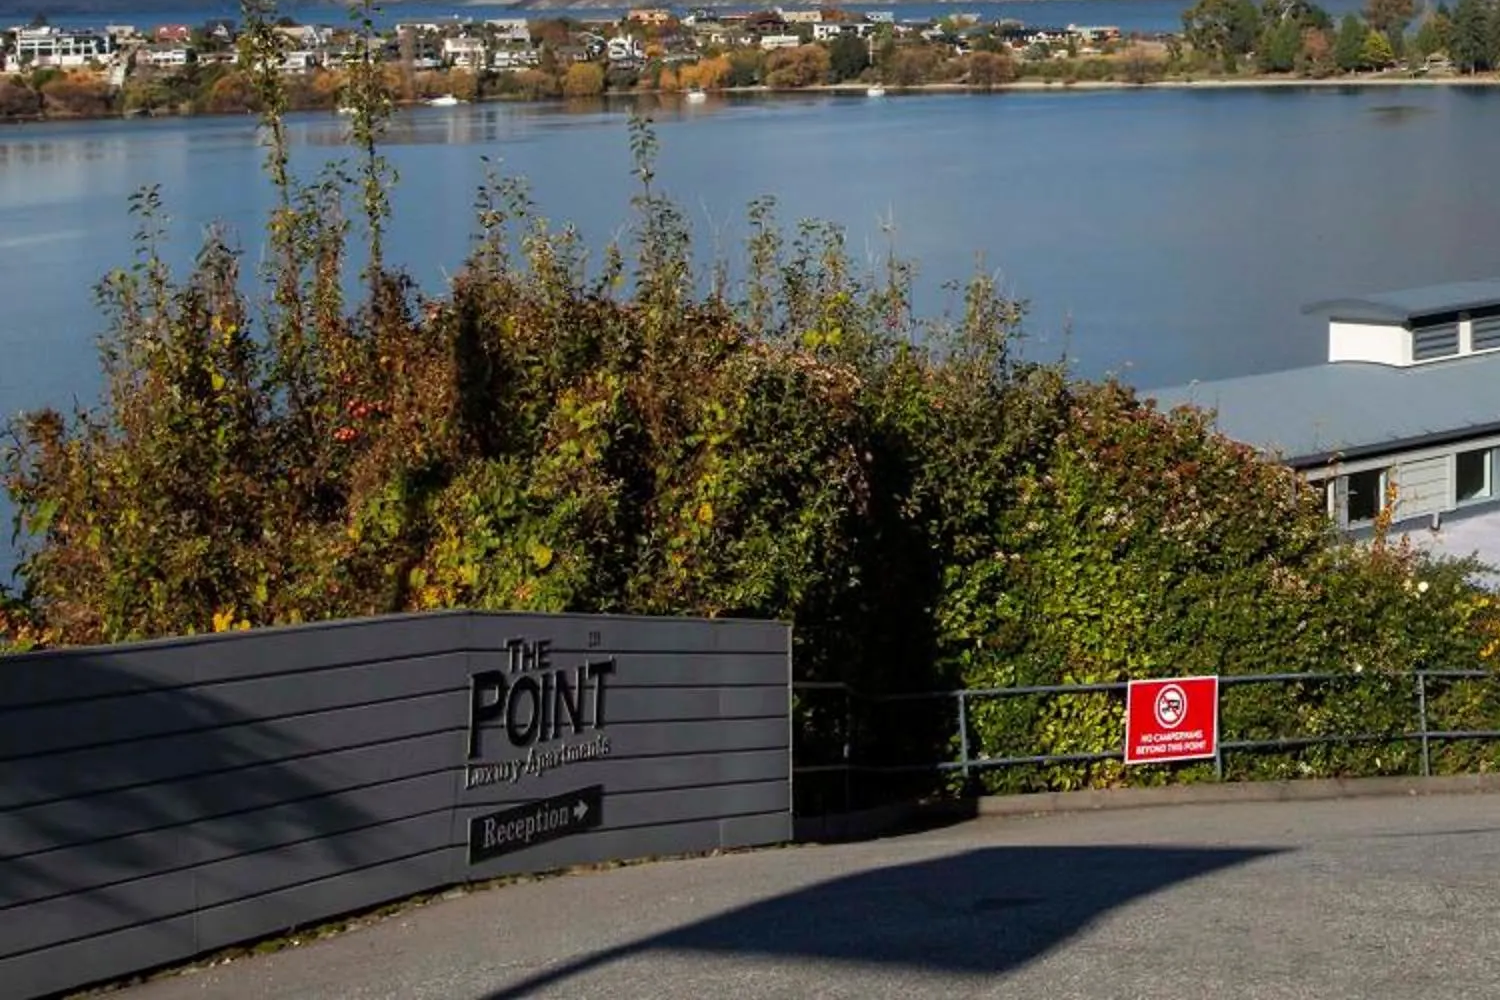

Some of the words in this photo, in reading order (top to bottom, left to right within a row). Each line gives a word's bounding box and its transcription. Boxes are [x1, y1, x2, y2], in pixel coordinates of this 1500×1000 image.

[503, 637, 553, 674] THE
[467, 655, 617, 760] POINT
[464, 758, 522, 790] Luxury
[524, 734, 612, 777] Apartments
[483, 802, 569, 848] Reception
